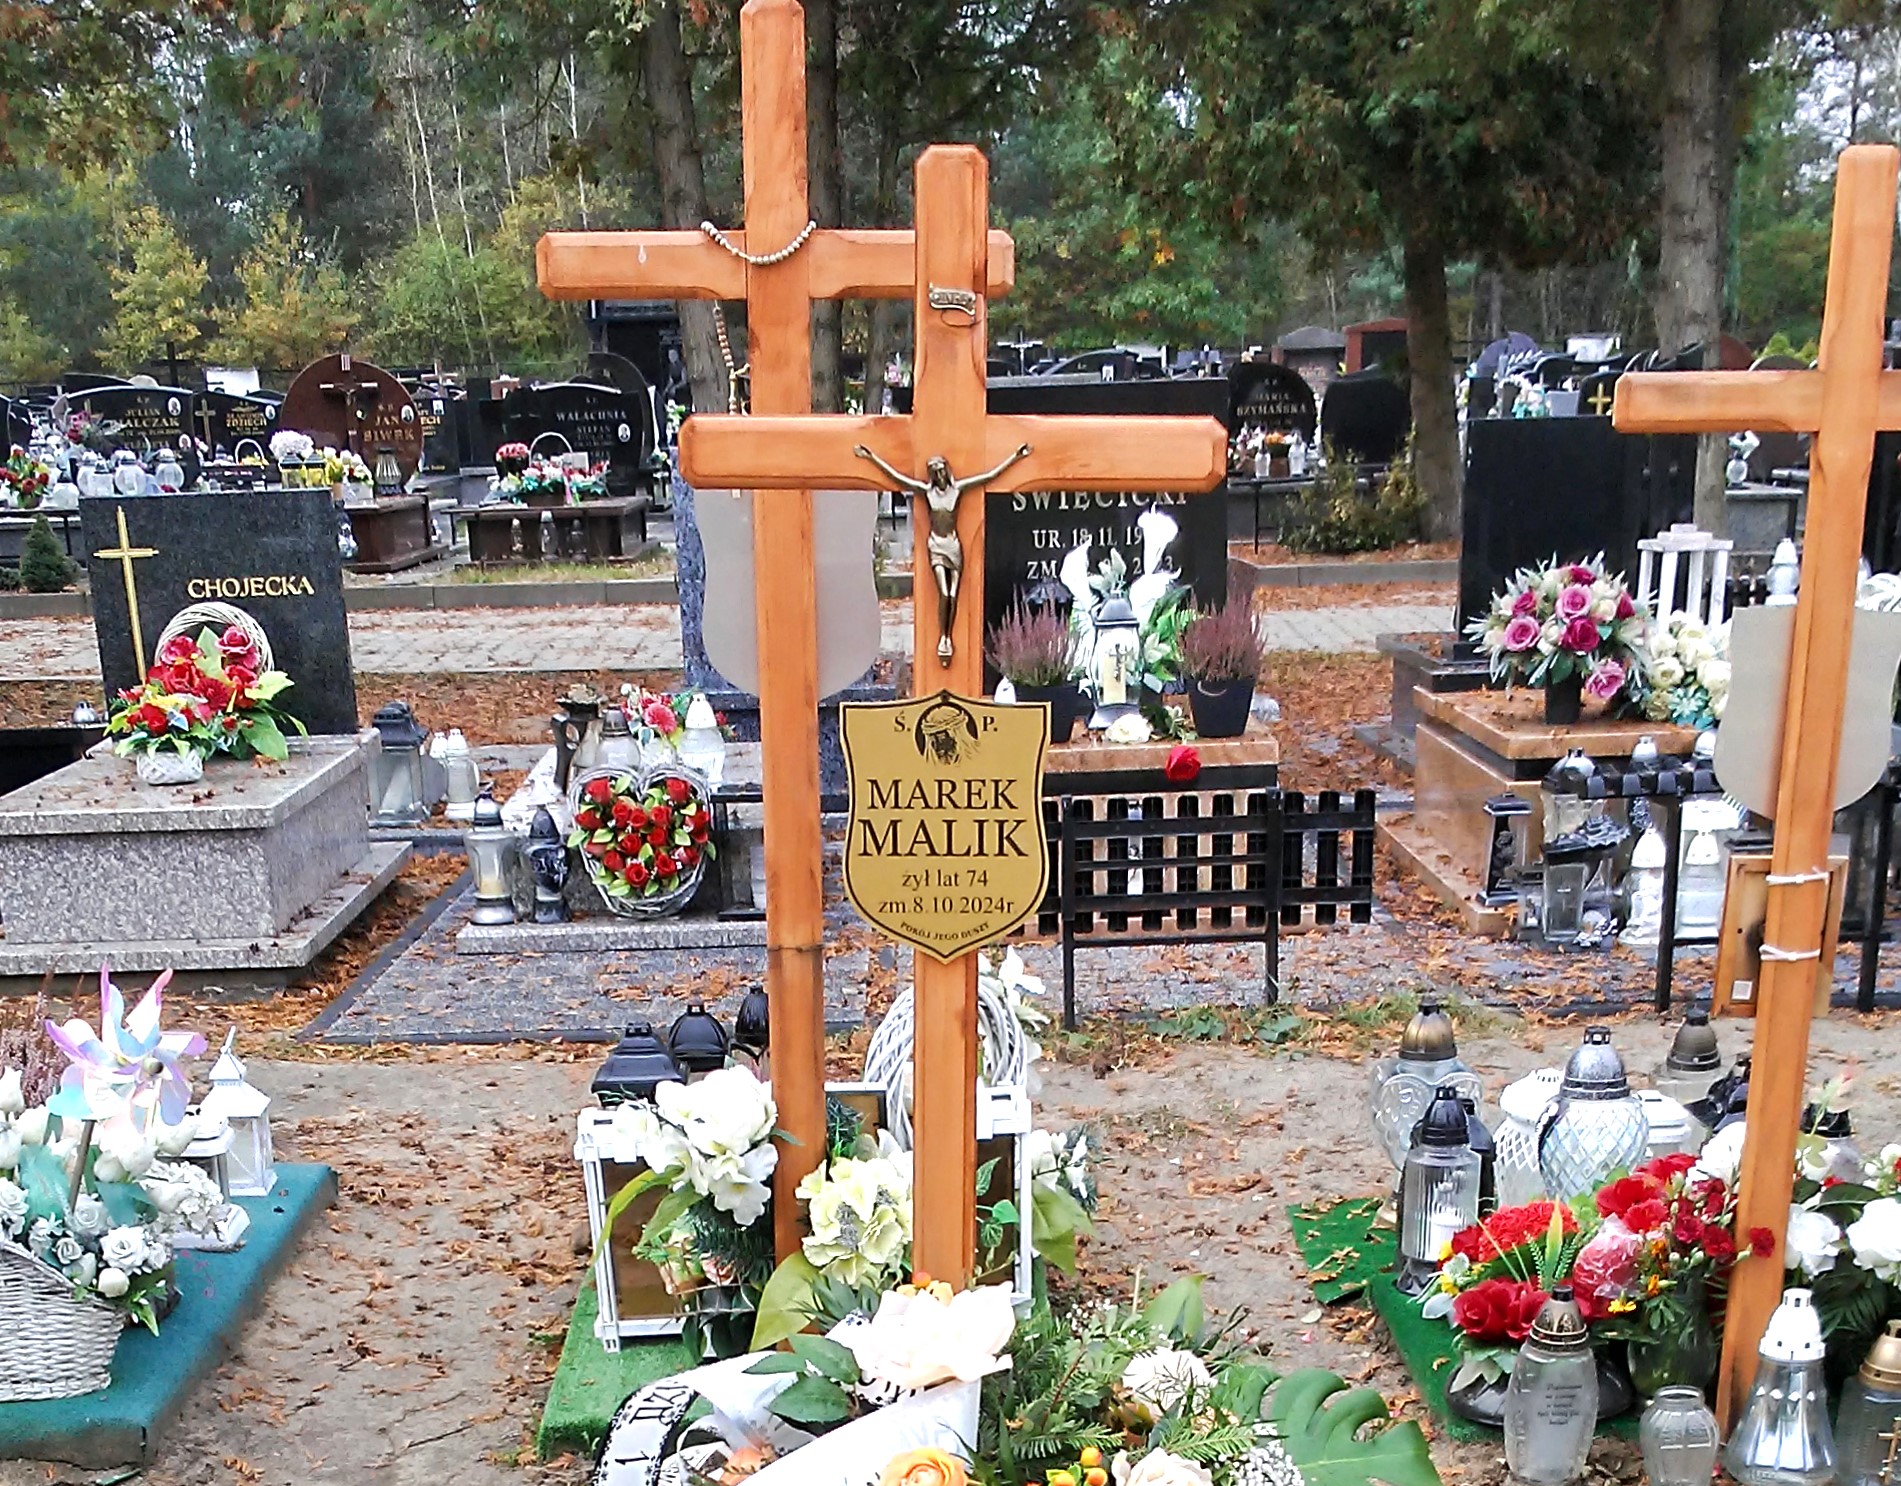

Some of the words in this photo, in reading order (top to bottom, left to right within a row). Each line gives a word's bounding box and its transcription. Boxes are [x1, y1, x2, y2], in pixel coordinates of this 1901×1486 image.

[375, 415, 400, 426] JAN
[1032, 529, 1066, 549] UR.
[187, 575, 316, 598] CHOJECKA
[894, 710, 911, 732] Ś.
[982, 716, 998, 732] P.
[867, 778, 1018, 810] MAREK
[858, 818, 1029, 857] MALIK
[901, 868, 930, 891] żył
[937, 868, 959, 887] lat
[967, 869, 989, 887] 74
[900, 920, 931, 939] POKÓJ
[932, 932, 960, 941] JEGO
[960, 921, 990, 939] DUSZY
